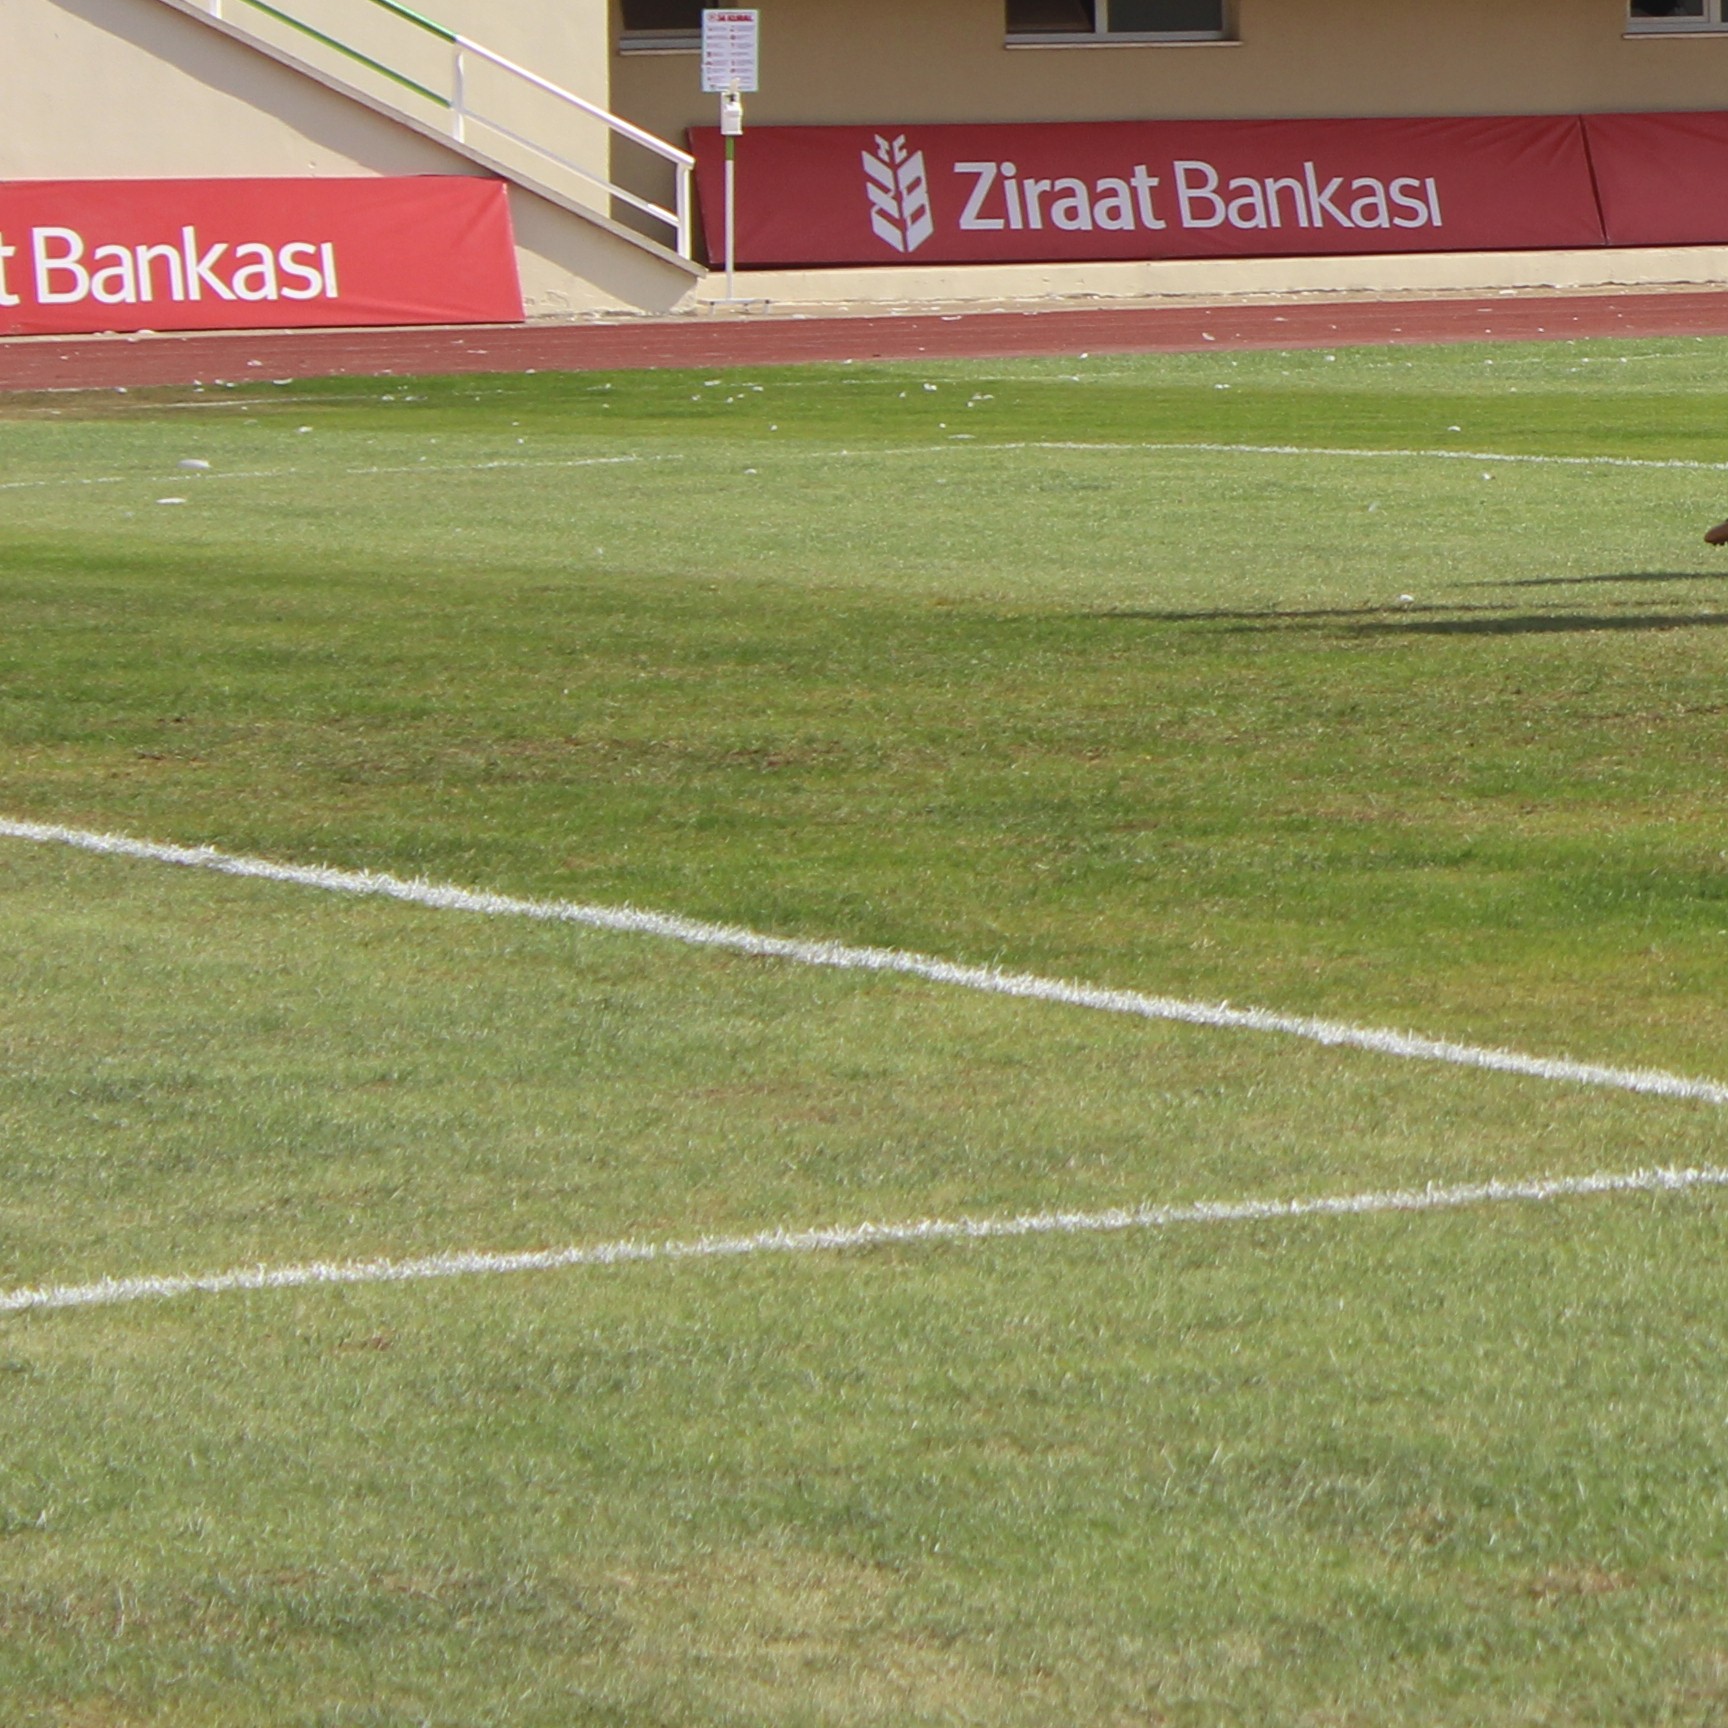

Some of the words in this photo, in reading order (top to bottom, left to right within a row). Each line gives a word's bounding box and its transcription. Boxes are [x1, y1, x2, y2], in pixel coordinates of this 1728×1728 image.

[953, 160, 1166, 231] Ziraat
[1173, 160, 1443, 229] Bankası
[31, 225, 339, 305] Bankası
